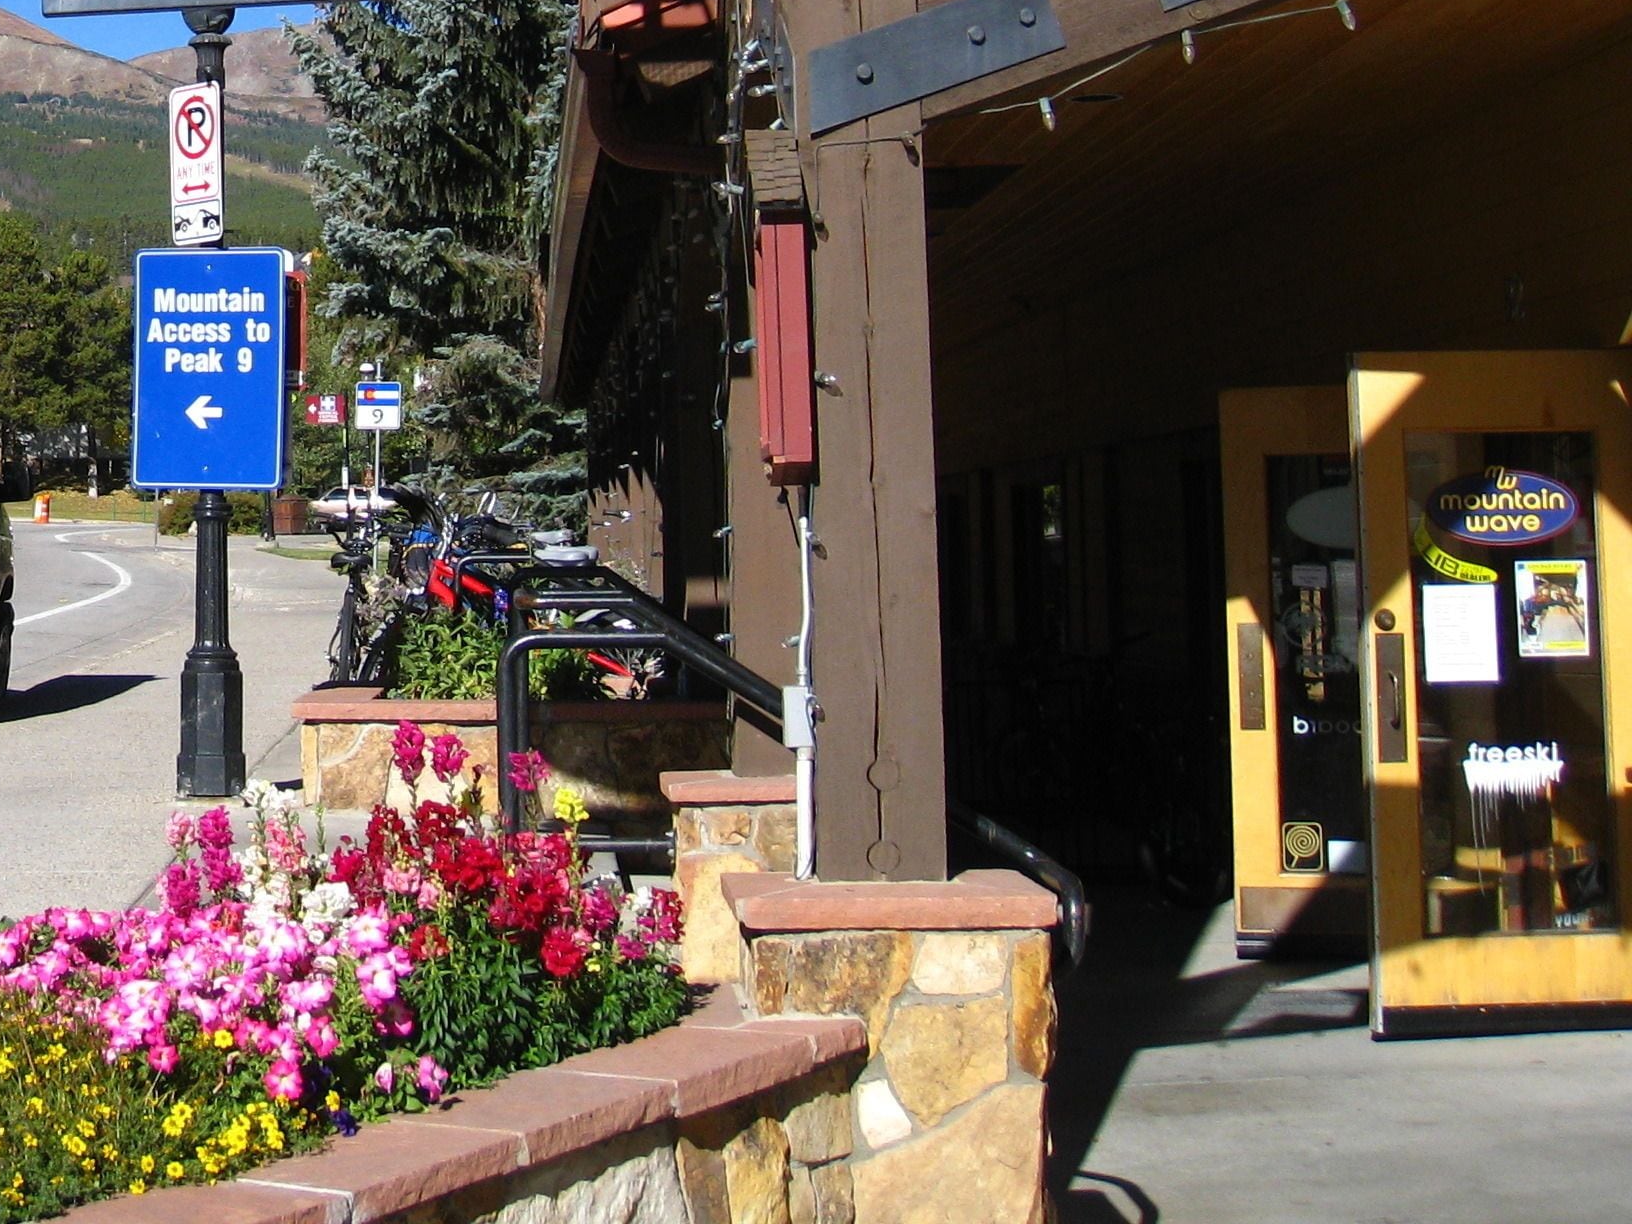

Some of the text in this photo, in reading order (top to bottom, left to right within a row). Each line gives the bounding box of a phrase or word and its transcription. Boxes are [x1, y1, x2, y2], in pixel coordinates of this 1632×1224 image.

[176, 161, 216, 180] ANY TIME
[153, 287, 266, 313] Mountain
[147, 318, 271, 343] Access to
[164, 347, 253, 373] Peak 9
[372, 408, 384, 424] 9
[1440, 487, 1565, 510] mountain
[1465, 514, 1542, 532] wave
[1468, 741, 1560, 762] freeski
